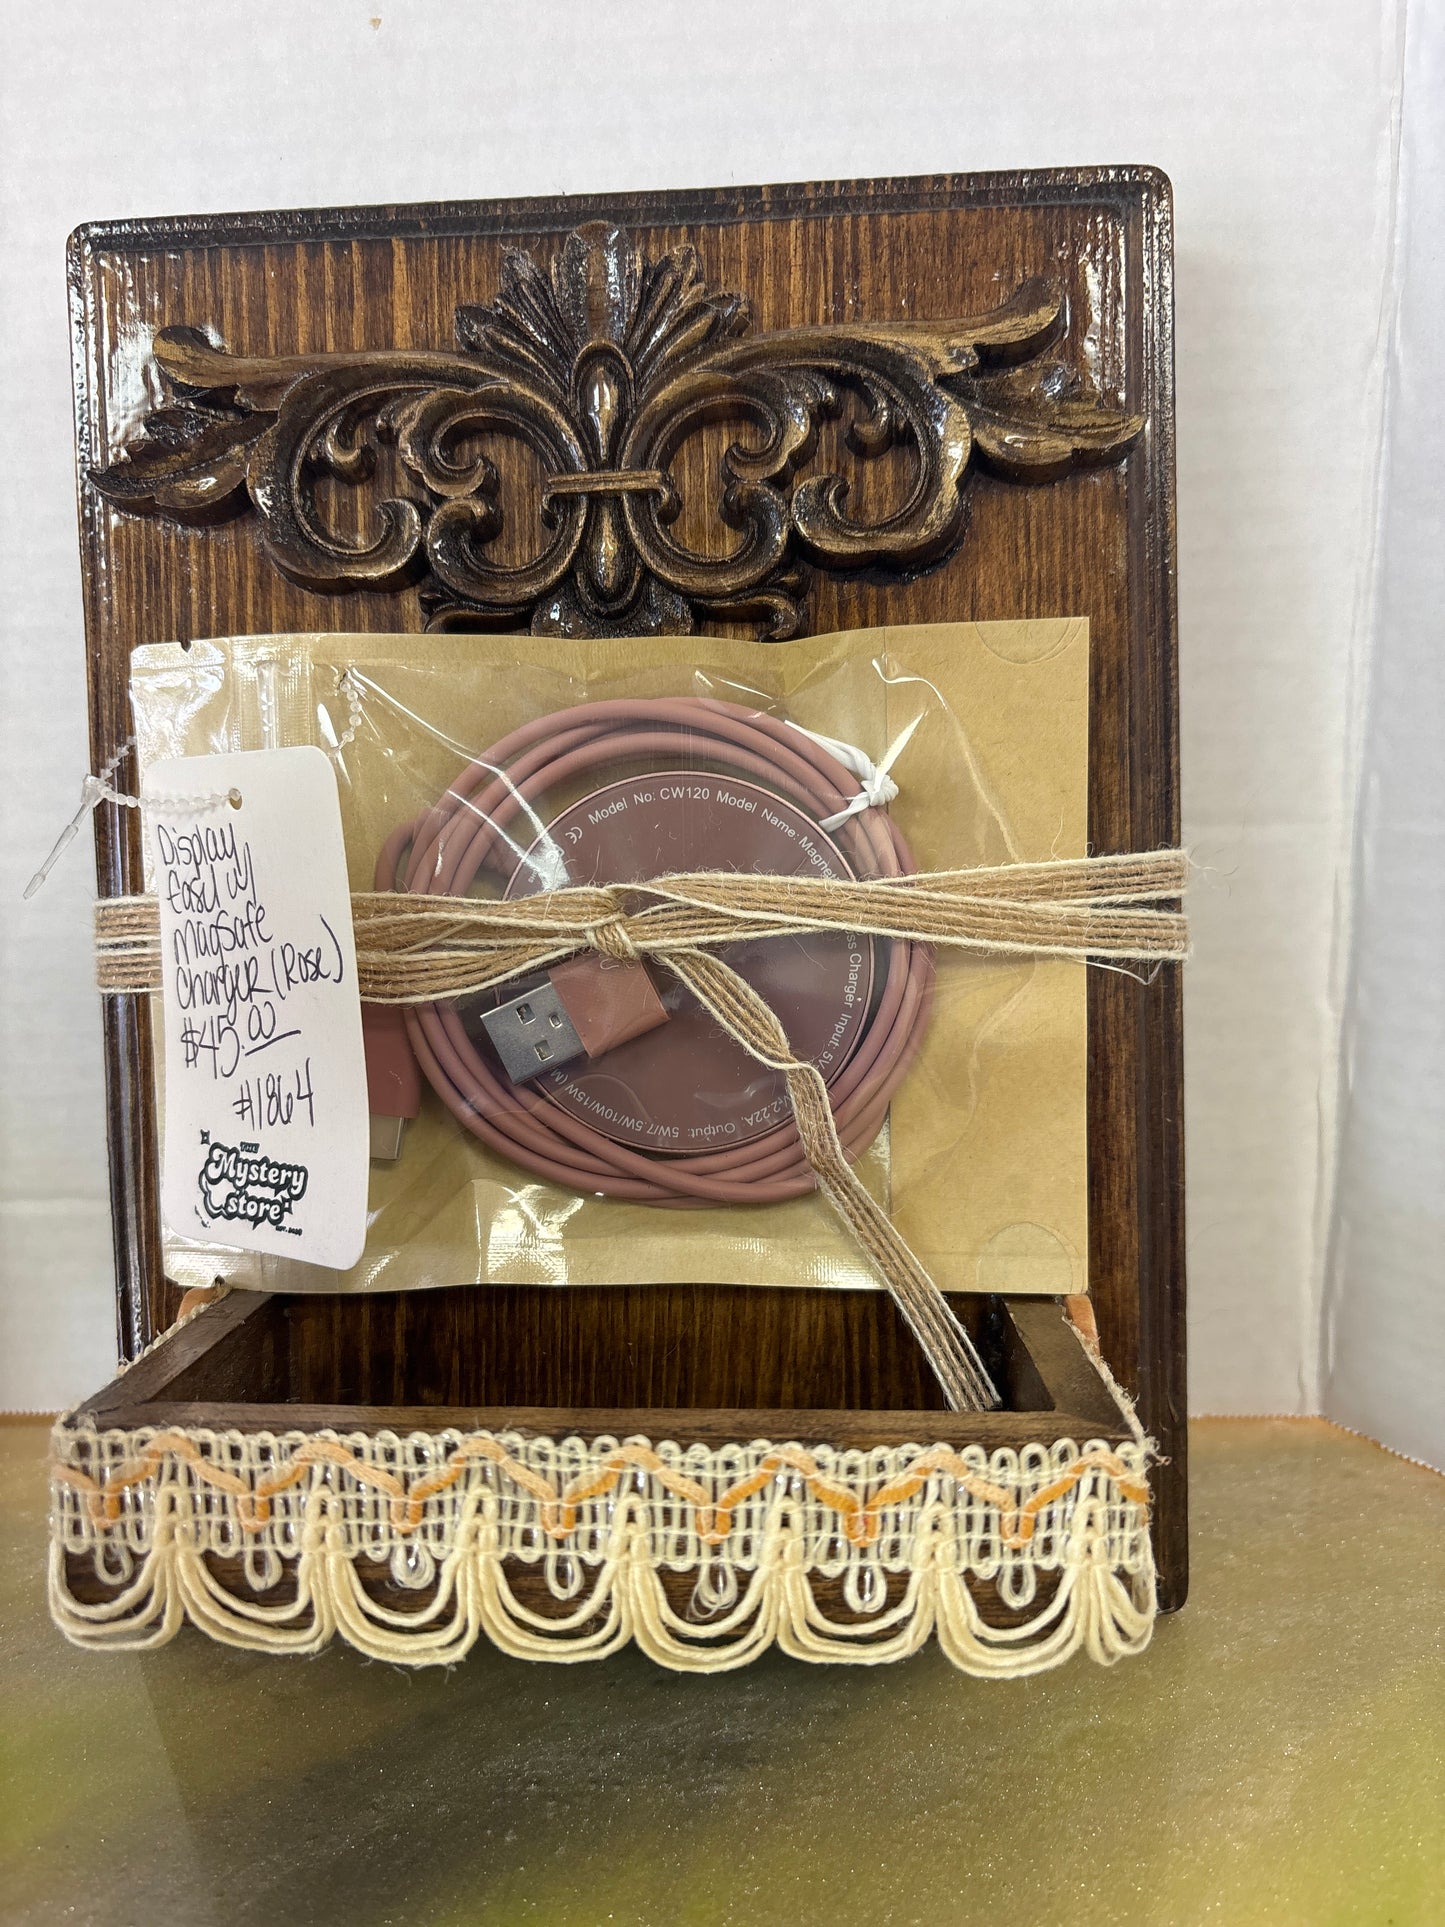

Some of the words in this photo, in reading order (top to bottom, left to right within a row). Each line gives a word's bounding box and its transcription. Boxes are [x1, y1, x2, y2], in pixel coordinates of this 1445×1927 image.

[588, 797, 629, 825] Model
[633, 792, 656, 806] No:
[659, 786, 710, 801] CW120
[716, 790, 758, 813] Model
[761, 808, 800, 841] Name:
[157, 822, 242, 879] Display
[843, 953, 862, 1008] Charger
[827, 1012, 853, 1050] Input:
[232, 1057, 315, 1132] #1864
[687, 1122, 736, 1139] Output:
[205, 1146, 306, 1197] Mystery
[226, 1192, 281, 1220] store
